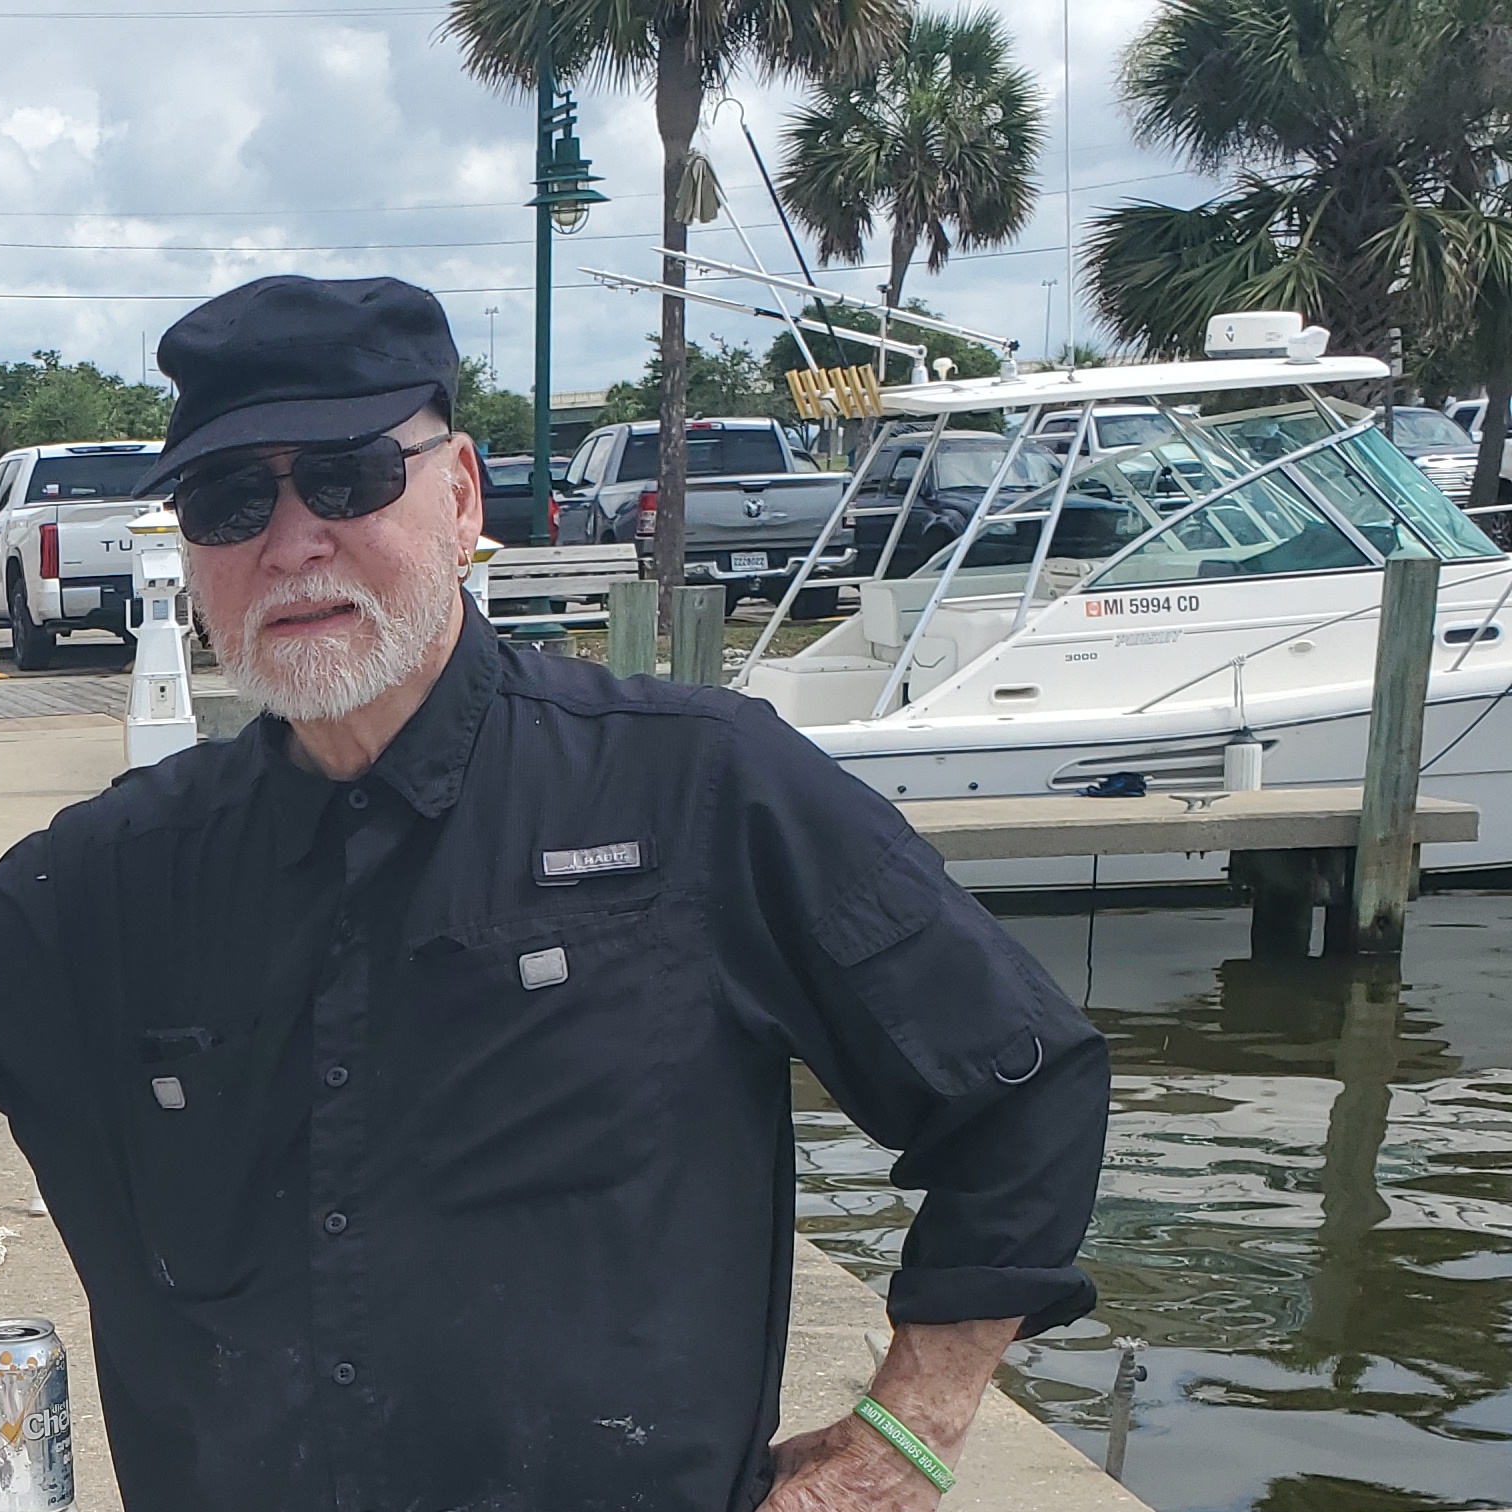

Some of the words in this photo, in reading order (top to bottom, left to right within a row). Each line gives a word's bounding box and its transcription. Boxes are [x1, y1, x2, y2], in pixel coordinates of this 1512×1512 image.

[1103, 599, 1124, 615] MI
[1129, 596, 1172, 614] 5994
[1177, 595, 1200, 612] CD
[1064, 652, 1098, 662] 3000
[22, 1401, 70, 1441] Che
[861, 1403, 882, 1422] LOVE
[881, 1421, 922, 1458] SOMEONE
[918, 1454, 937, 1473] FOR
